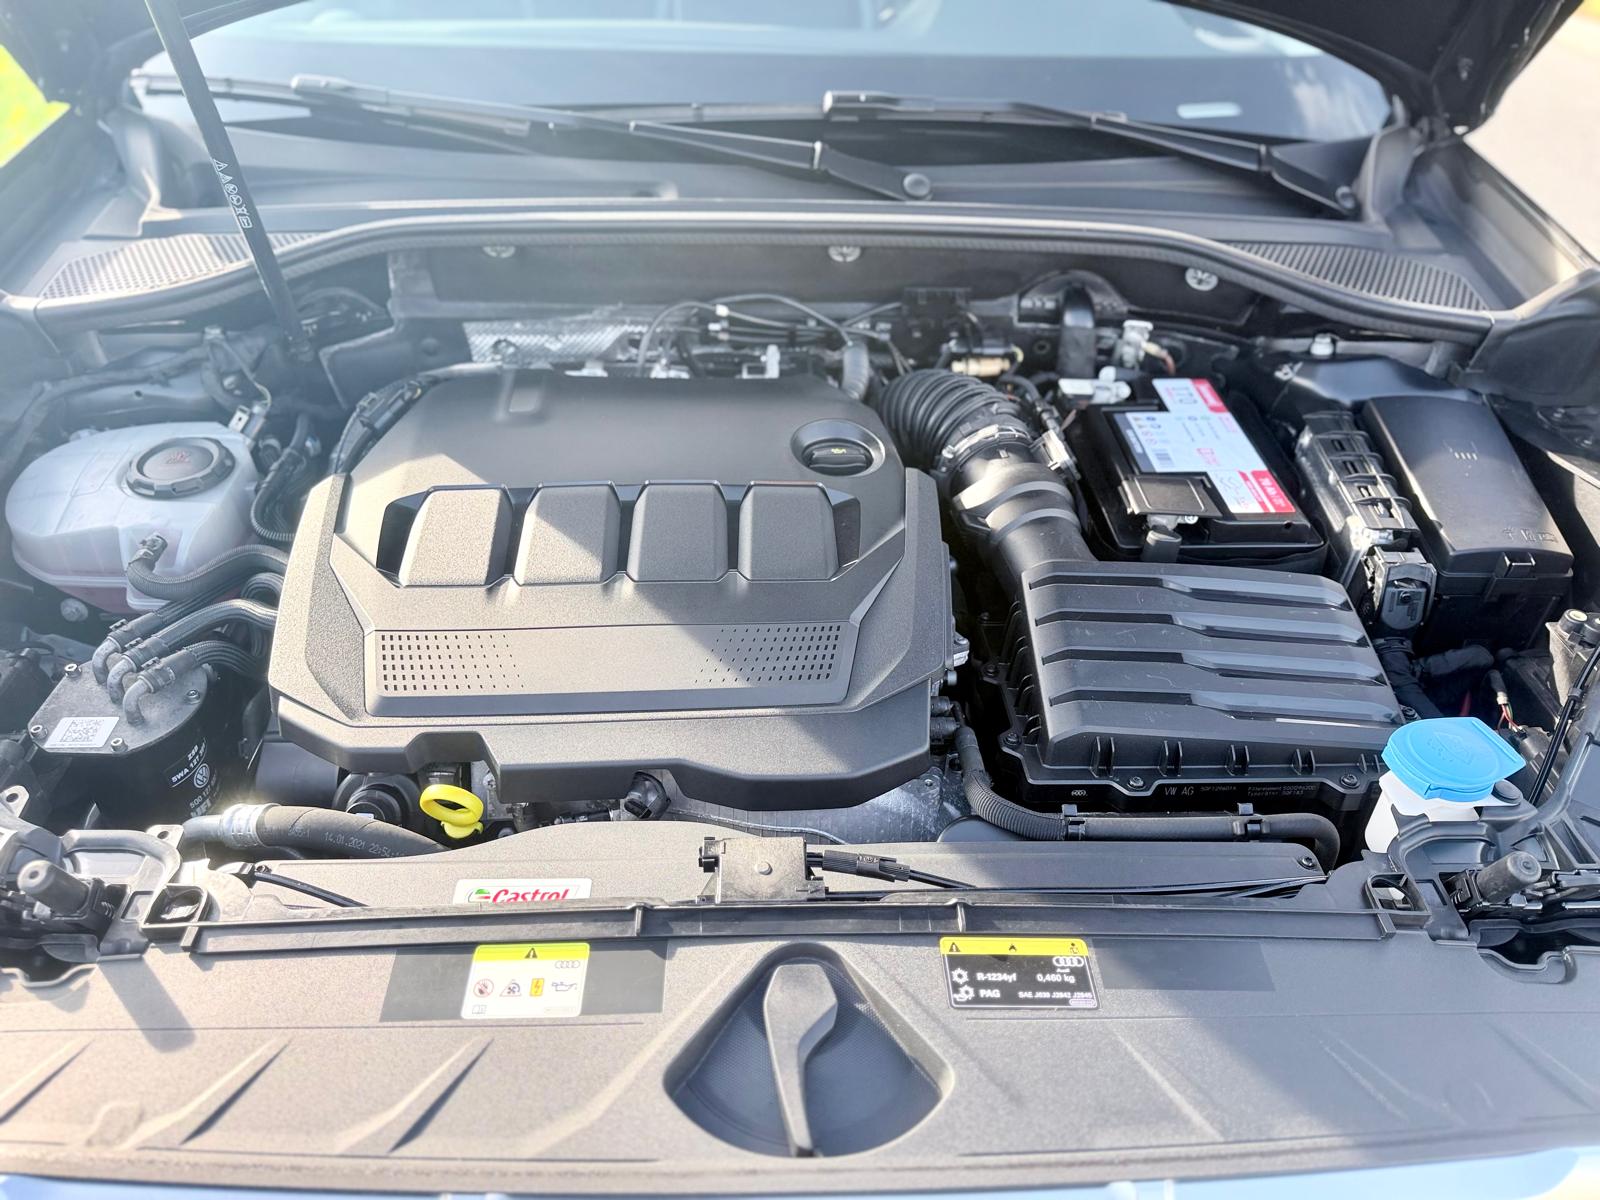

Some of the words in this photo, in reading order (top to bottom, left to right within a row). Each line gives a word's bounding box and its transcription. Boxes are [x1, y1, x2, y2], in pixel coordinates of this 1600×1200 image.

[1164, 786, 1178, 796] VW
[1181, 786, 1195, 796] AG
[976, 973, 1017, 983] R-1234yf
[1063, 974, 1076, 983] kg
[979, 989, 1001, 998] PAG
